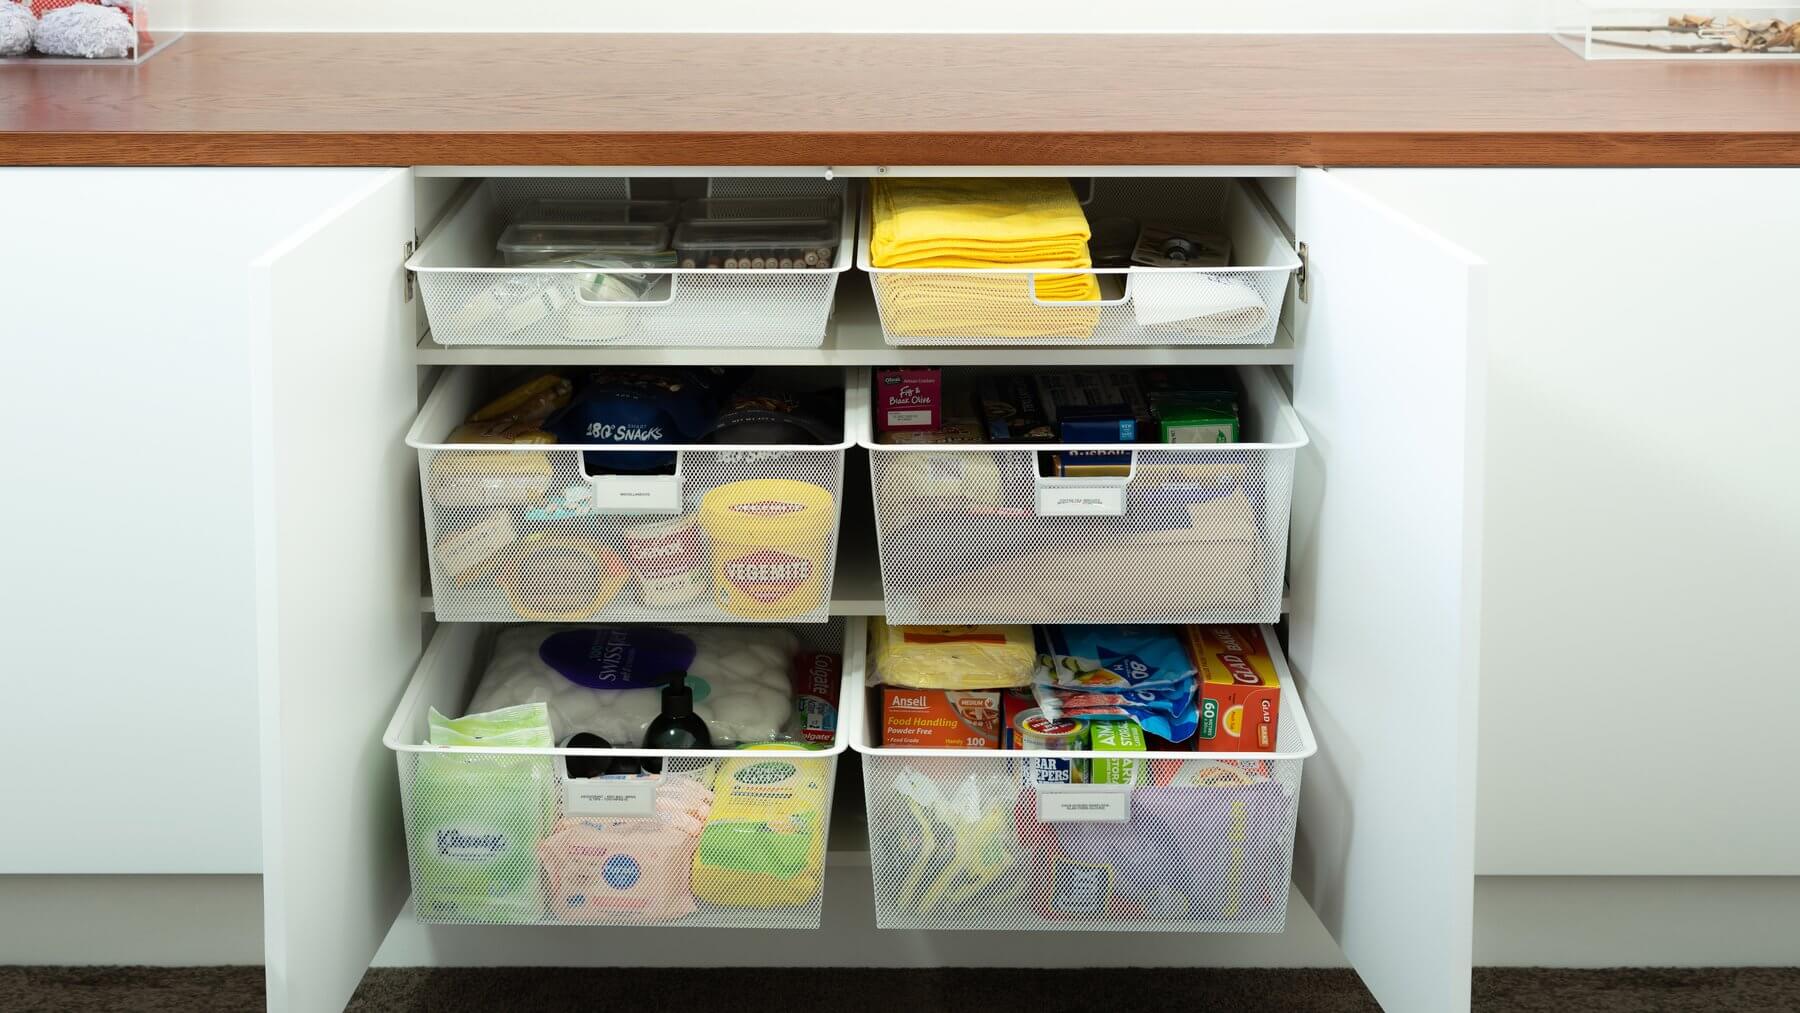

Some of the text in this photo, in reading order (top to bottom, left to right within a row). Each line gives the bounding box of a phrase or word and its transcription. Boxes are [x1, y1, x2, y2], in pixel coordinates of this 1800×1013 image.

[911, 396, 932, 405] Olive
[614, 425, 663, 441] SNACKS
[724, 561, 811, 583] VEGEMITE
[815, 655, 833, 695] Colgate
[1223, 654, 1260, 684] GLAD
[892, 695, 927, 707] Ansell
[1203, 702, 1215, 718] 60
[1261, 700, 1271, 722] GLAD
[887, 716, 911, 726] Food
[913, 717, 958, 729] Handling
[887, 726, 933, 735] Powder Free
[967, 737, 985, 746] 100
